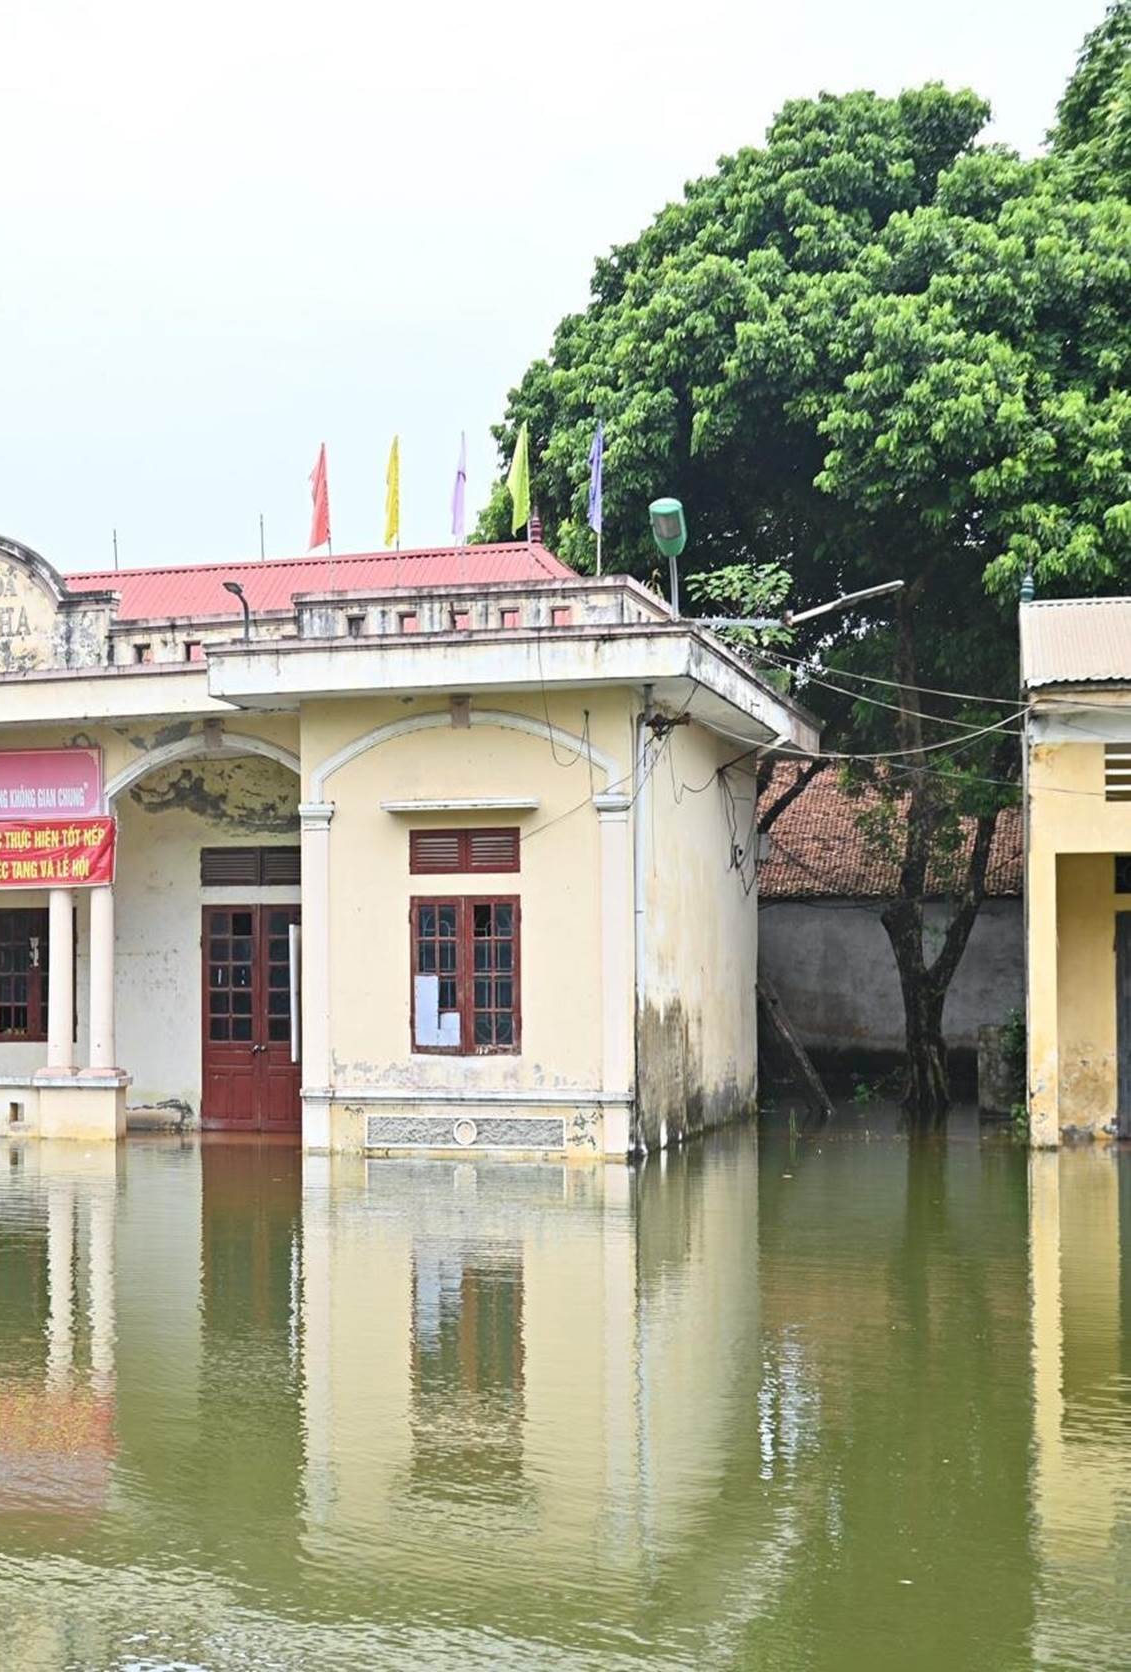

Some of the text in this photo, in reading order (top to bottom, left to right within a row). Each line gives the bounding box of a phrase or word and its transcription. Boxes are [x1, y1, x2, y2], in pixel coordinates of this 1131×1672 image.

[9, 784, 36, 809] KHÔNG
[37, 787, 57, 809] GIAN
[5, 828, 32, 853] THỰC
[34, 826, 60, 852] HIỆN
[62, 823, 81, 847] TỐT
[83, 822, 107, 847] NẾP
[12, 860, 38, 880] TANG
[39, 856, 55, 879] VÀ
[71, 855, 90, 881] HỘI
